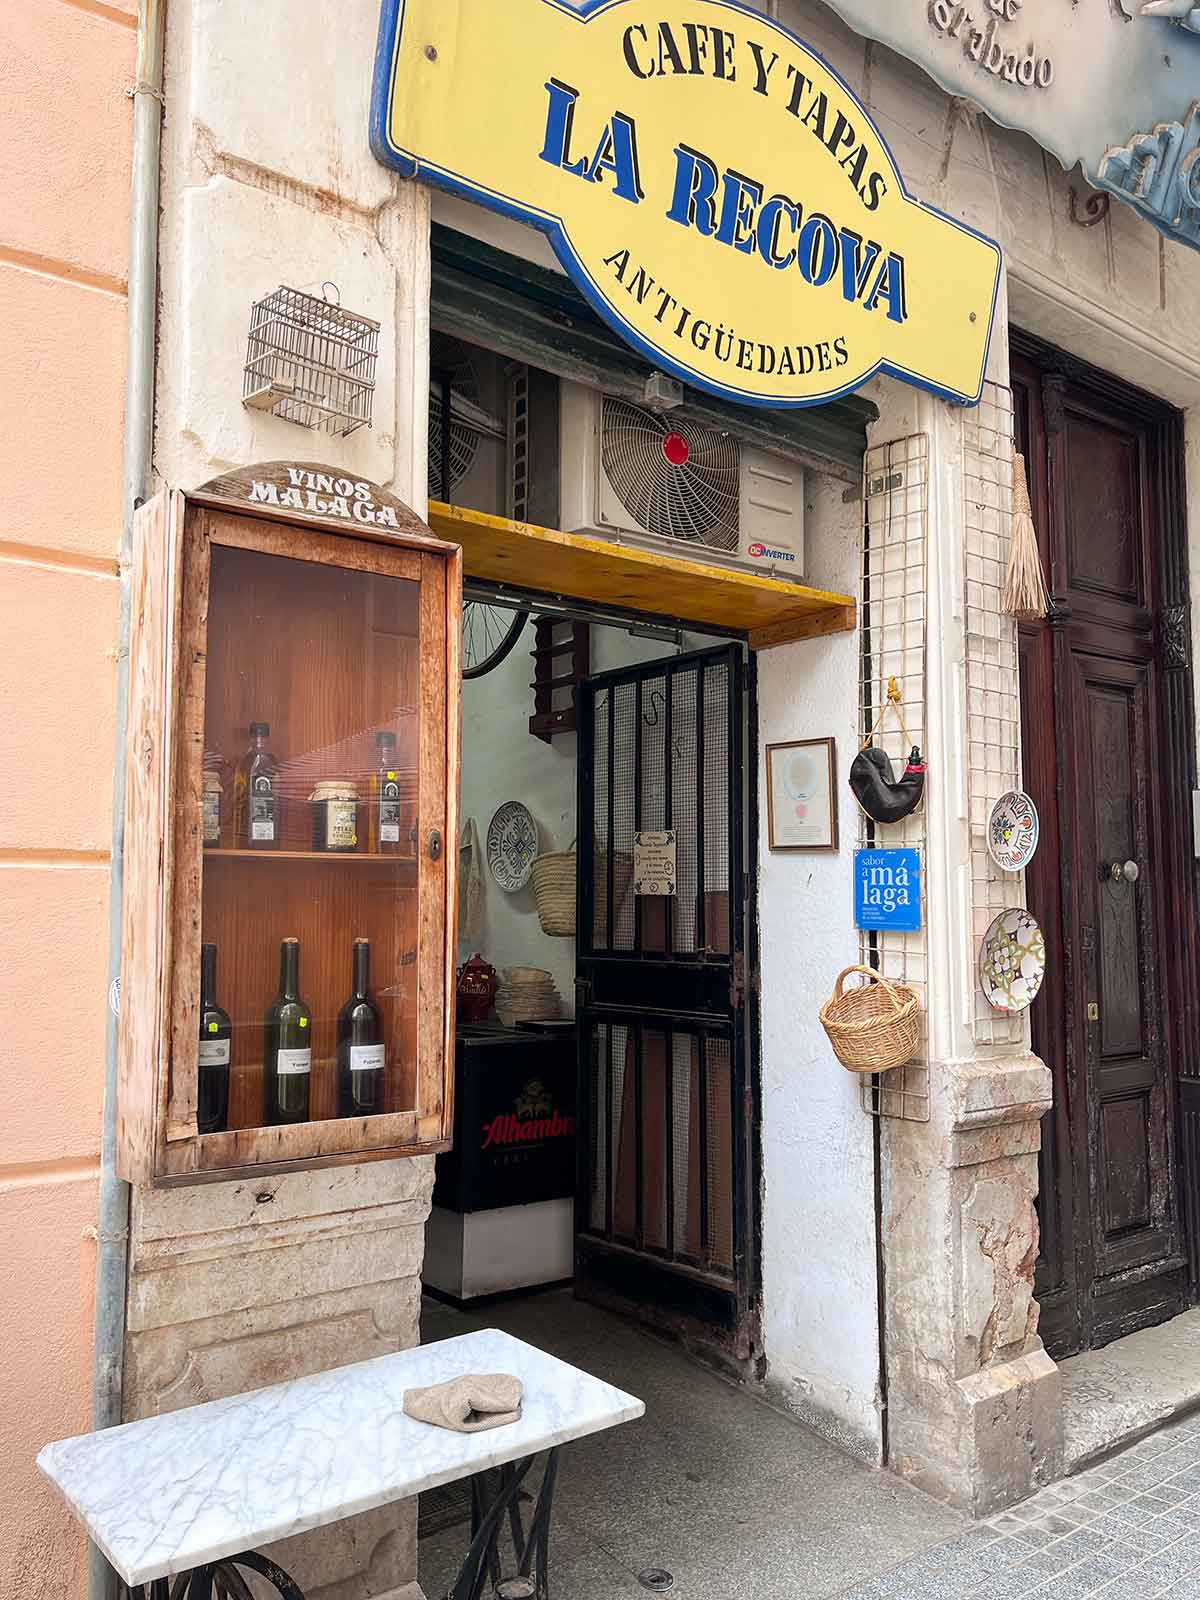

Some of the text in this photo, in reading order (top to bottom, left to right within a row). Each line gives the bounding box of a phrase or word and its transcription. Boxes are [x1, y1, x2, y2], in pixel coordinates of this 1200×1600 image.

[623, 23, 888, 212] CAFE Y TAPAS
[538, 77, 908, 325] LA RECOVA
[603, 248, 849, 377] ANTIGÜEDADES
[248, 480, 400, 527] MALAGA
[287, 467, 373, 501] VINOS
[862, 855, 884, 866] sabor
[870, 858, 911, 886] má
[862, 879, 911, 912] laga
